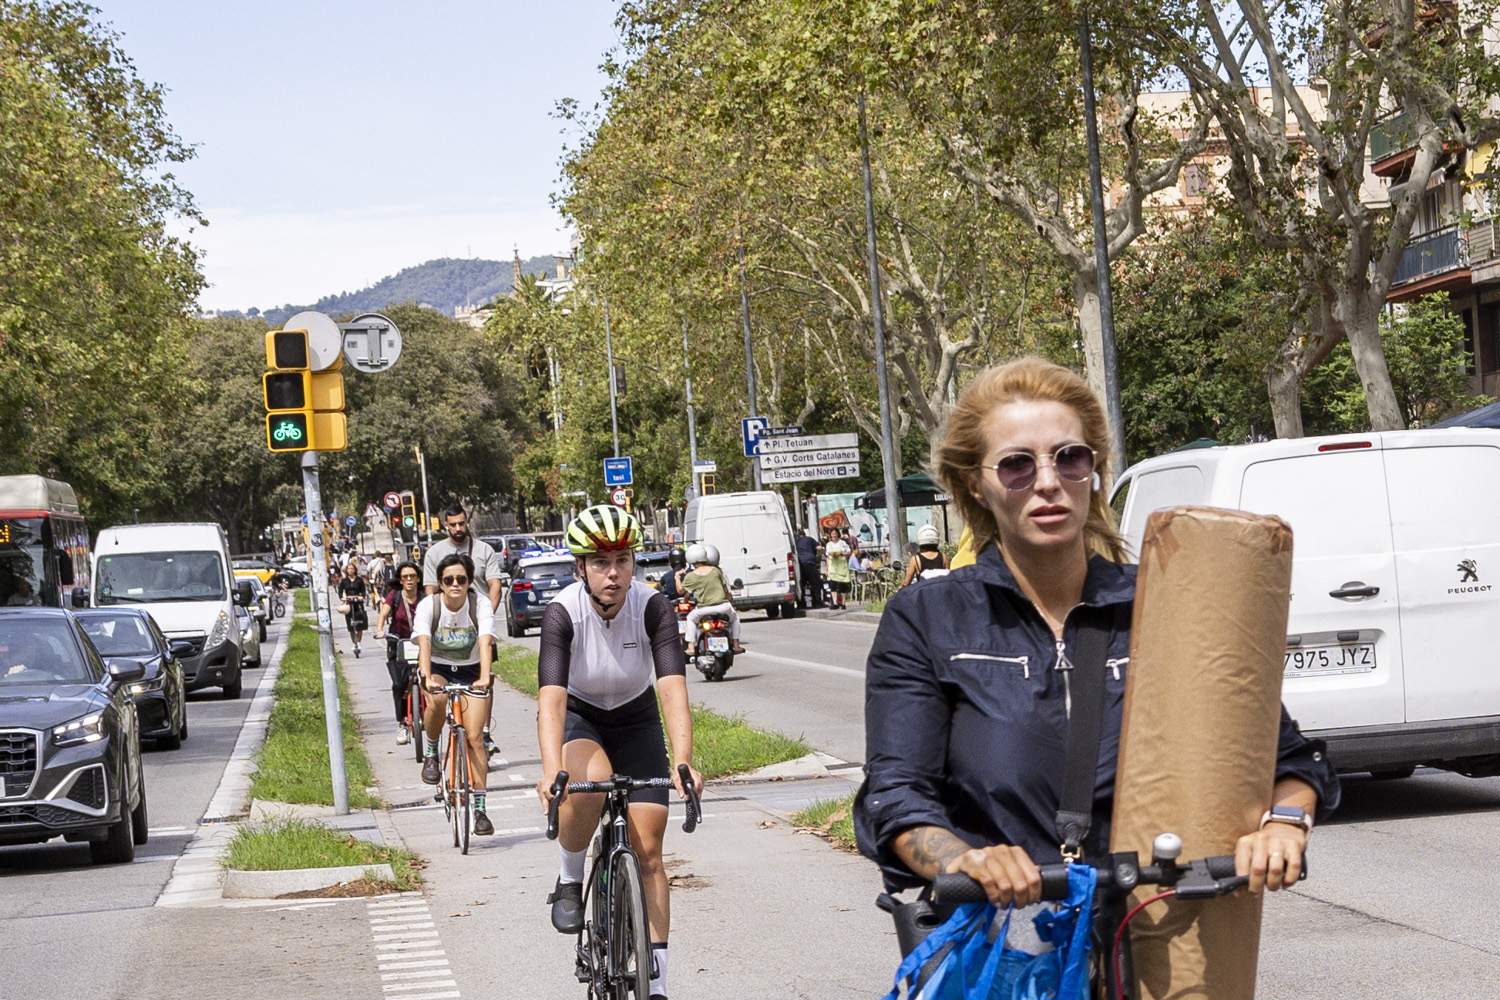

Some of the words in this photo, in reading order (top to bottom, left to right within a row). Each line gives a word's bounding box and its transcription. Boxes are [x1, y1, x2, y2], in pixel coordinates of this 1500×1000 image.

[772, 440, 783, 448] Pl.
[785, 438, 813, 448] Tetuan
[792, 453, 814, 463] Corts
[816, 450, 856, 461] Catalanes
[803, 468, 815, 477] del
[816, 466, 835, 476] Nord
[1447, 585, 1493, 594] PEUGEOT
[1283, 650, 1330, 669] 7975
[1336, 647, 1372, 666] JYZ
